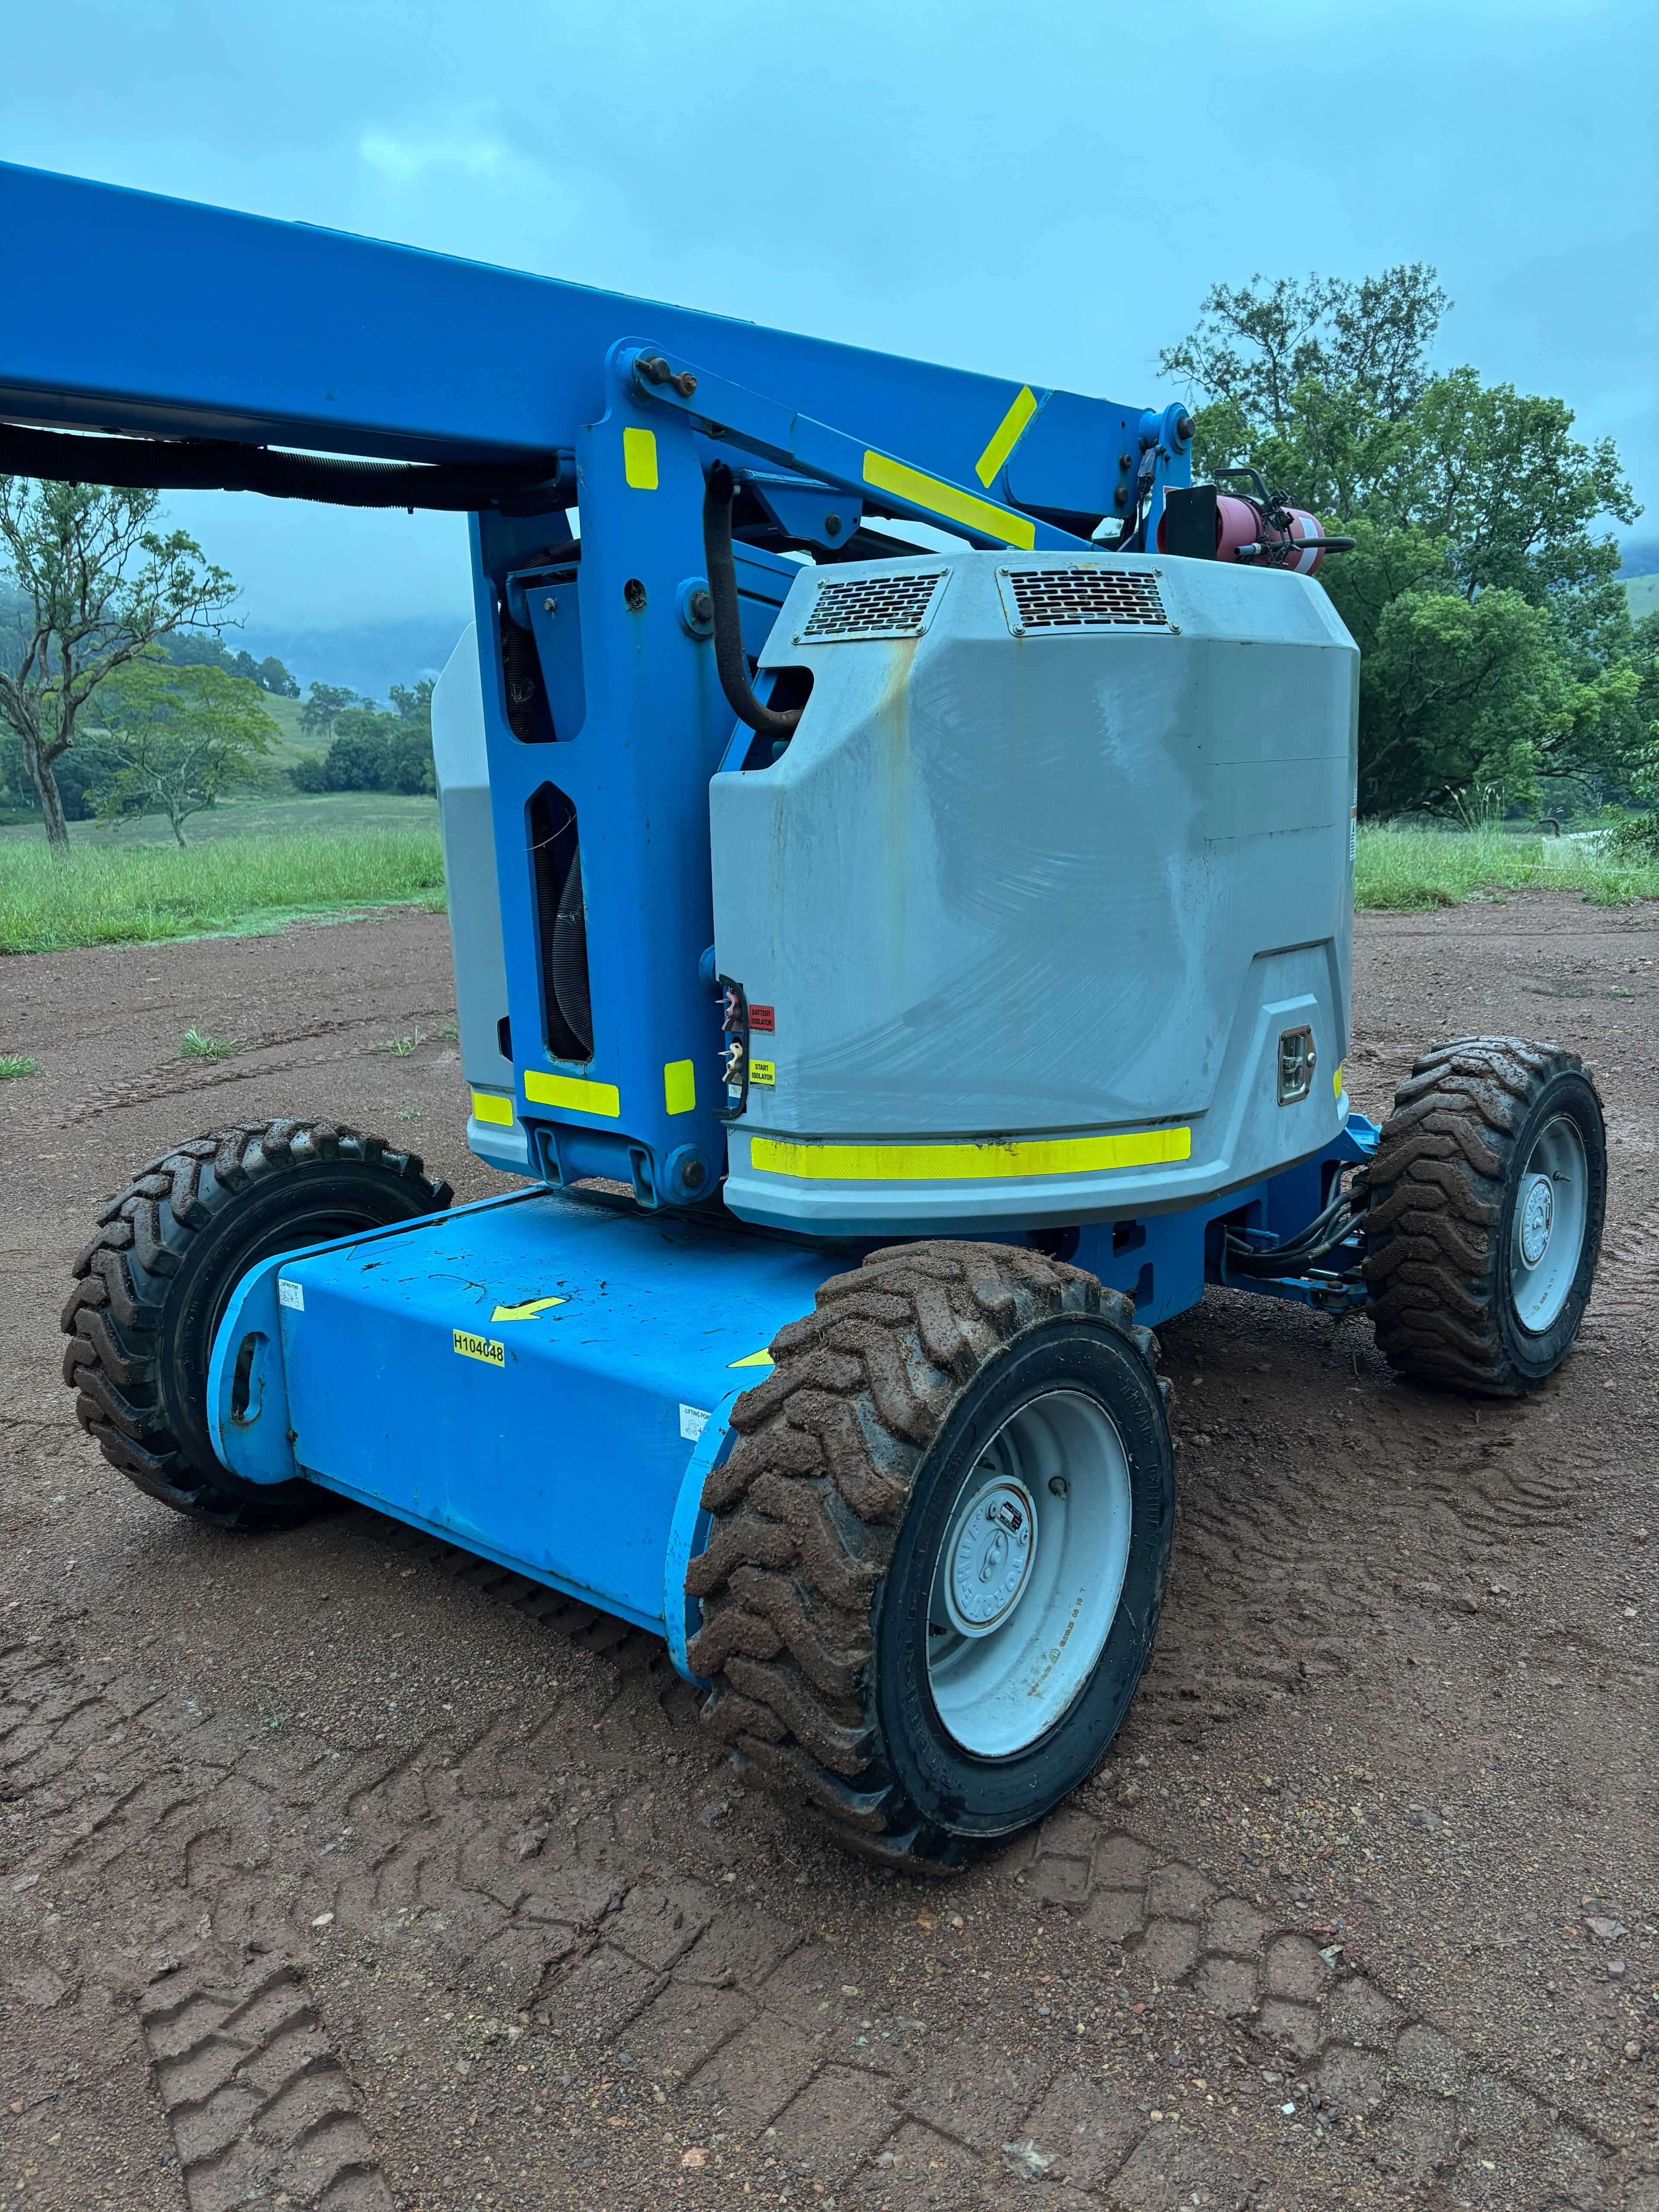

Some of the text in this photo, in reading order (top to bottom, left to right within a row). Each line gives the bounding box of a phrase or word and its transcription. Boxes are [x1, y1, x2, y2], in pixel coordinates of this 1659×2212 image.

[752, 1072, 772, 1081] ISOLATOR
[454, 1334, 504, 1362] H104048
[685, 1408, 700, 1417] LIFTING
